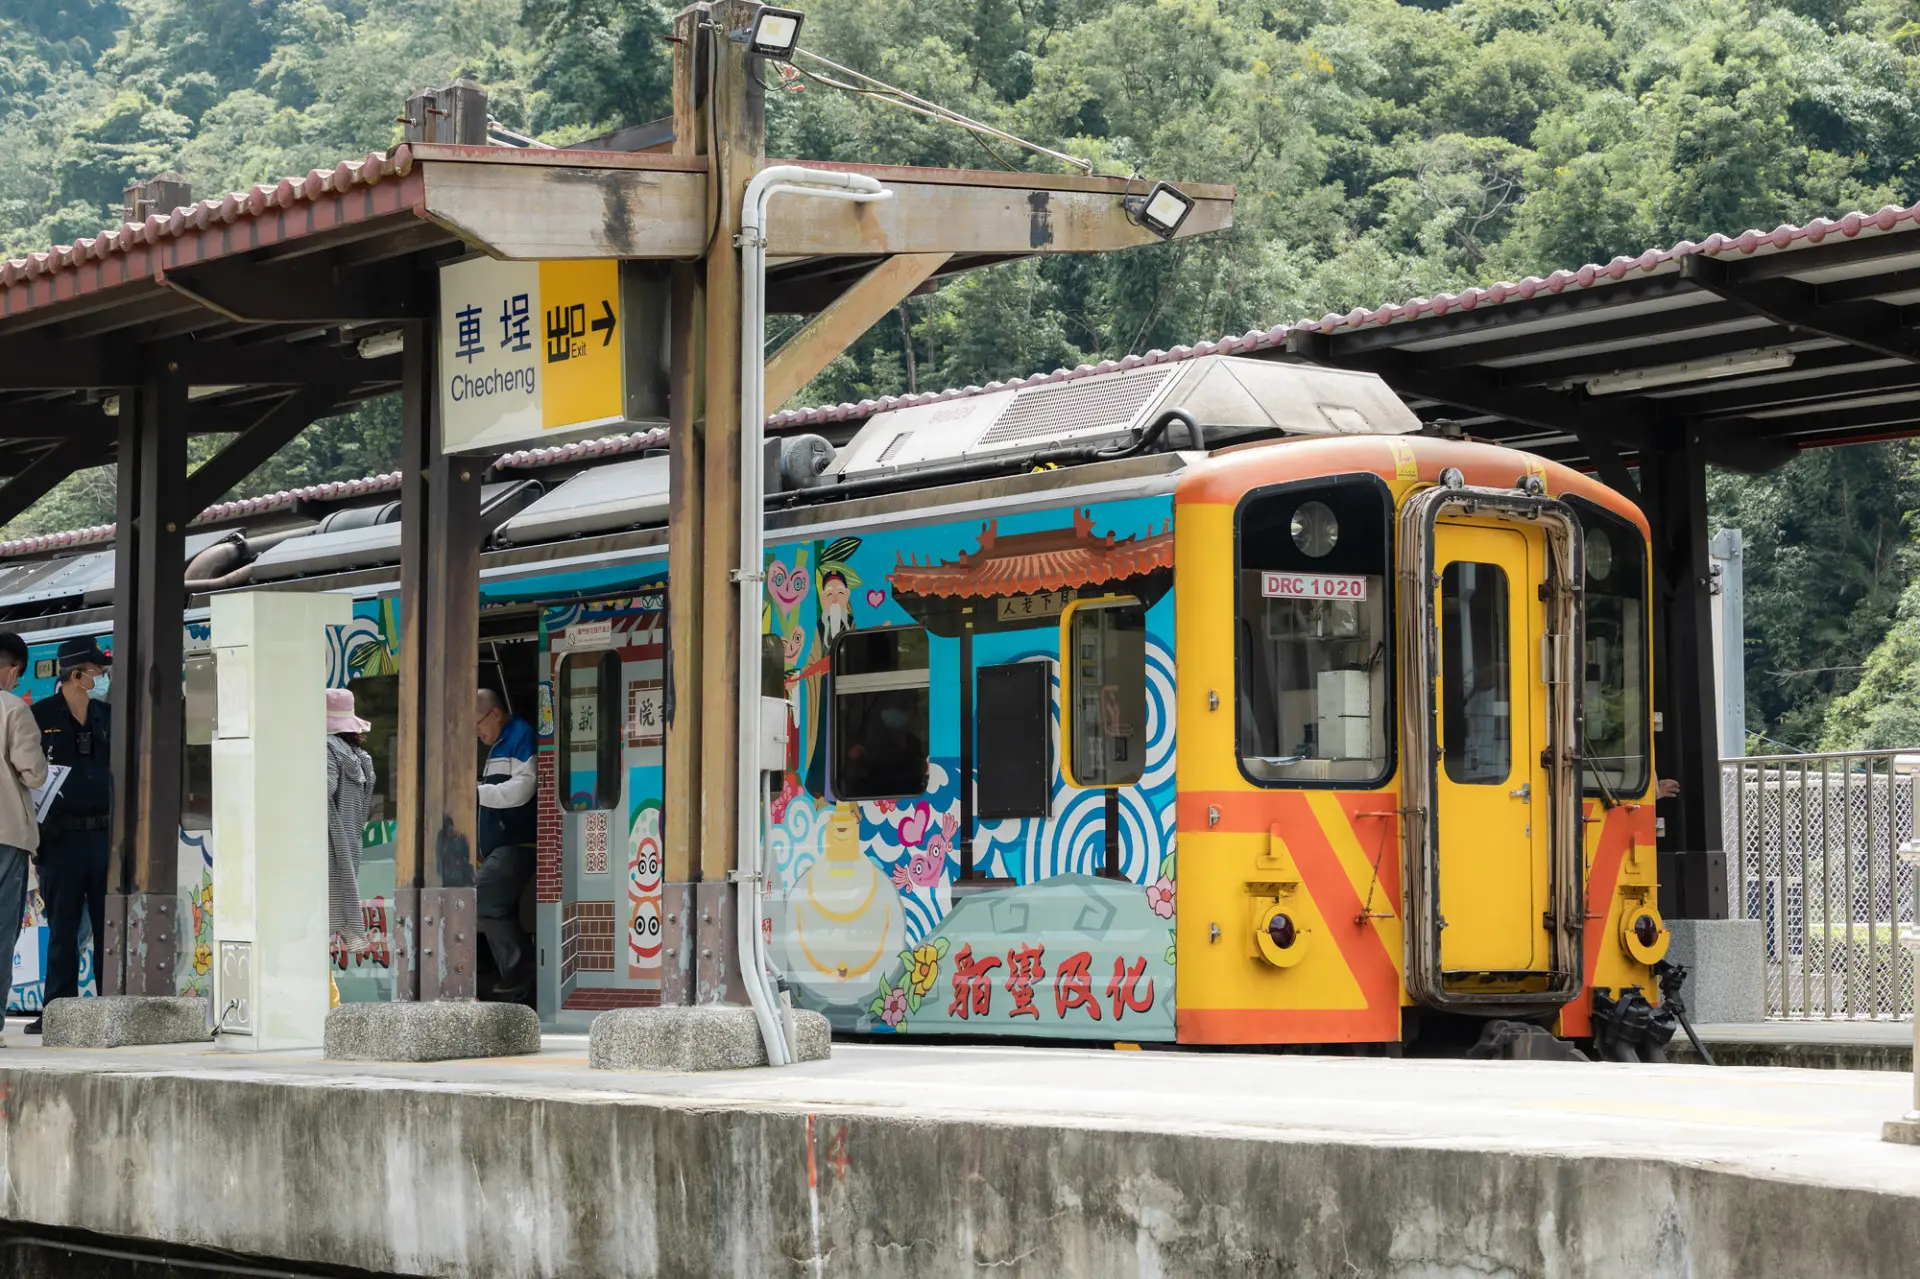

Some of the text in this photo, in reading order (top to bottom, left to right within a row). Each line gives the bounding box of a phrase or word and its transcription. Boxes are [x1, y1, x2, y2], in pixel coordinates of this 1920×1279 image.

[455, 293, 532, 364] 車埕
[547, 303, 586, 364] 出口
[571, 341, 587, 359] Exit
[451, 366, 535, 402] Checheng
[1268, 576, 1362, 597] DRC 1020
